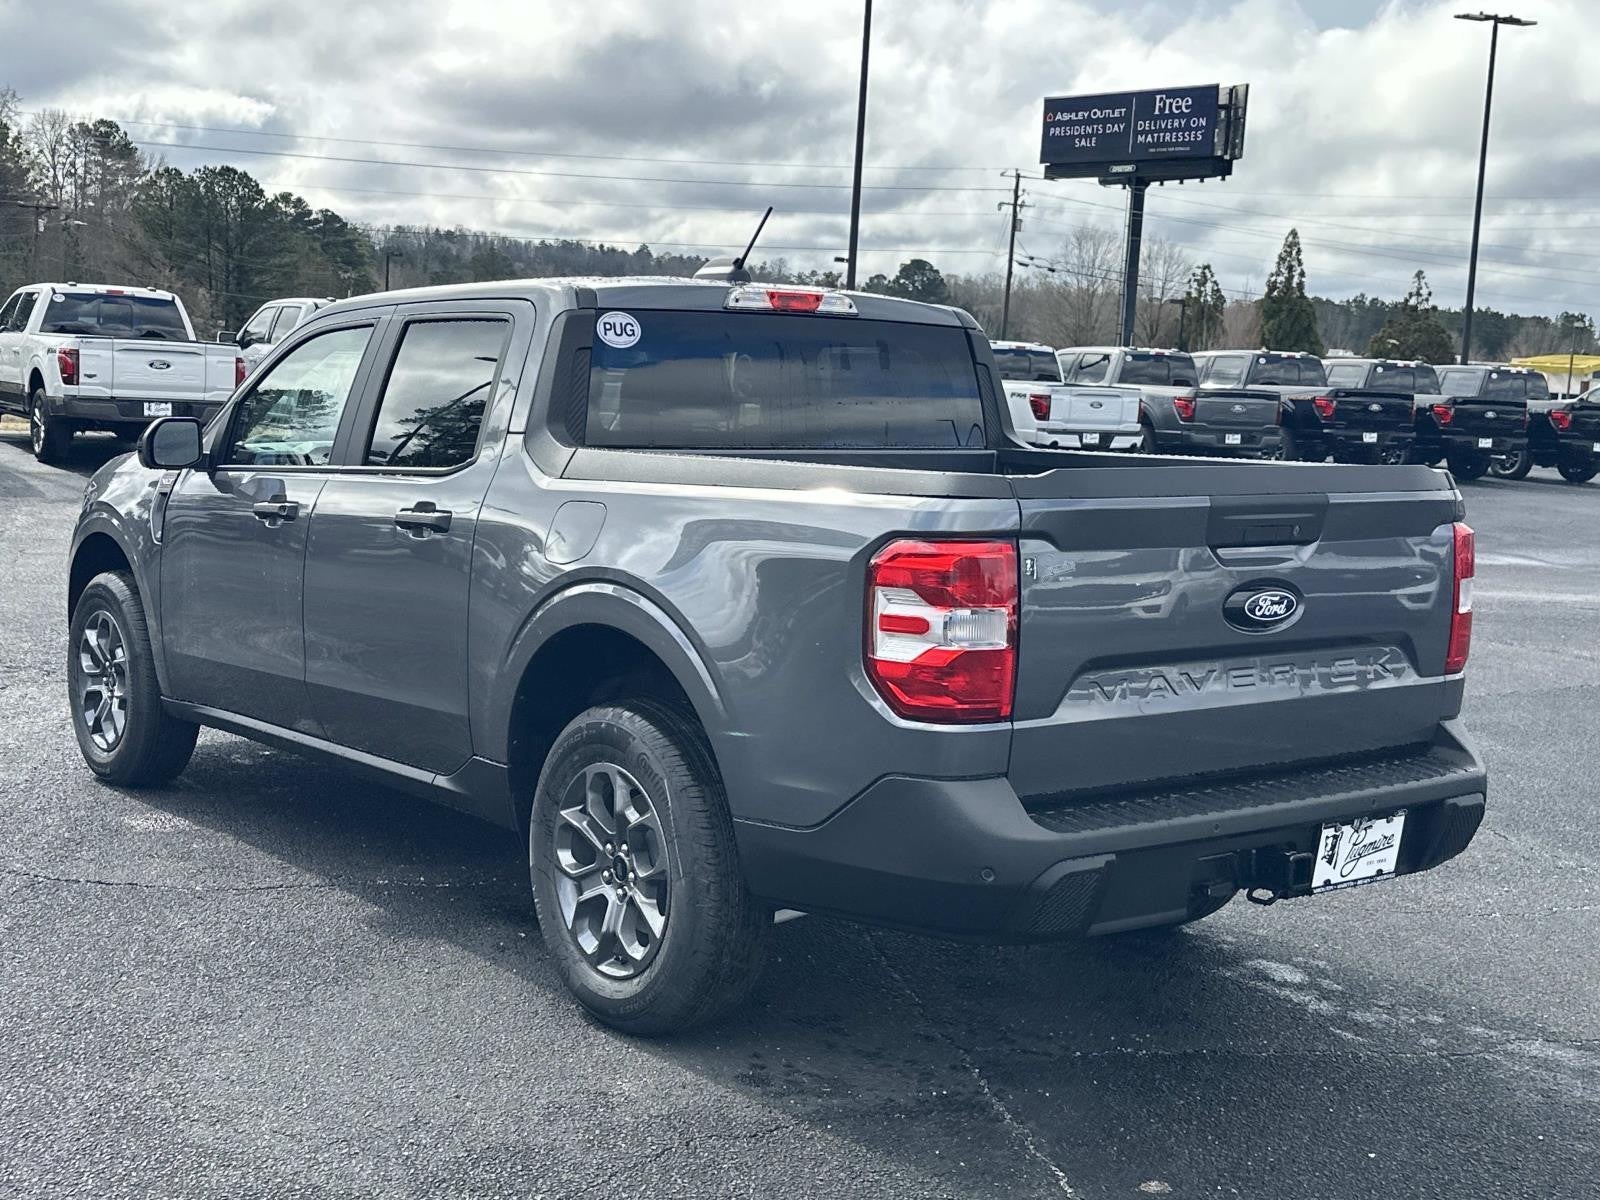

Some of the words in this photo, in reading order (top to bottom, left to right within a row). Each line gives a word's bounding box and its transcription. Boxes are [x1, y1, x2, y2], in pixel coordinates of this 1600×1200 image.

[1154, 94, 1192, 115] Free
[1055, 110, 1089, 121] ASHLEY
[1090, 108, 1126, 119] OUTLET
[1049, 124, 1103, 136] PRESIDENTS
[1106, 122, 1125, 133] DAY
[1137, 118, 1186, 130] DELIVERY
[1190, 116, 1207, 127] ON
[1074, 136, 1097, 148] SALE
[603, 322, 635, 337] PUG
[1255, 595, 1287, 616] Ford
[1089, 654, 1395, 702] MAVERICK
